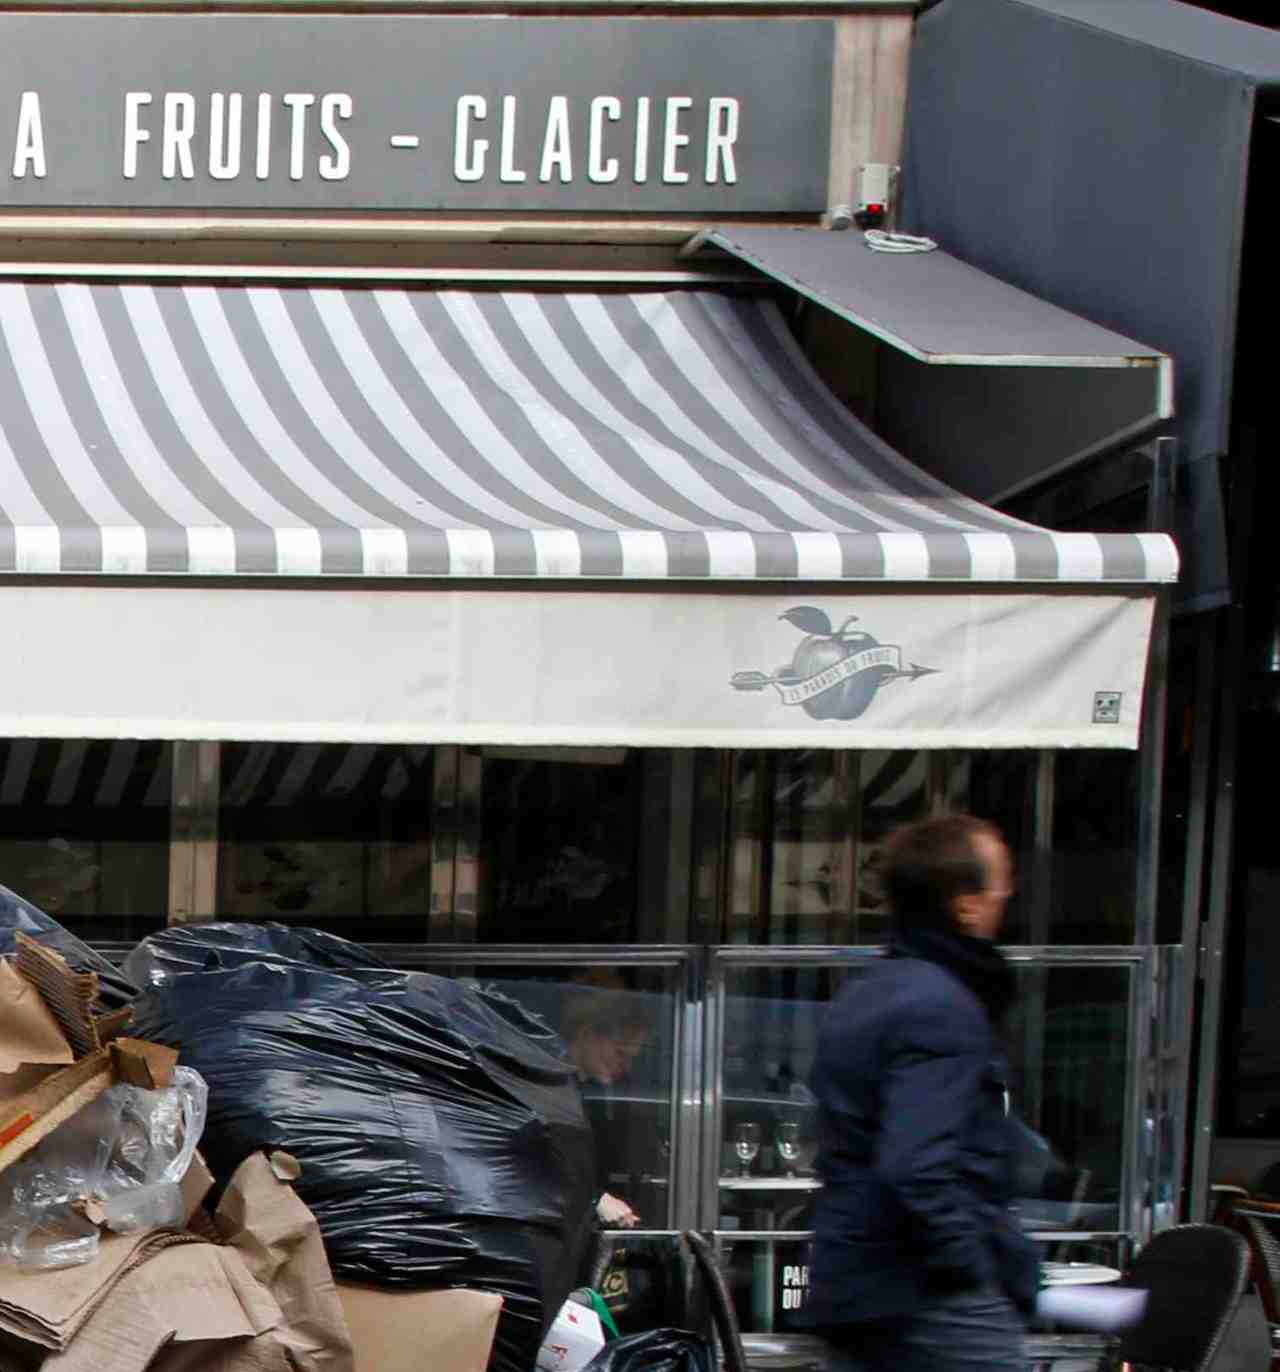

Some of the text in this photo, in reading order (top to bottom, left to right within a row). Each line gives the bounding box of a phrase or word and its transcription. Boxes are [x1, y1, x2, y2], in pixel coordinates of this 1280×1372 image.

[10, 90, 48, 180] A
[122, 91, 354, 183] FRUITS
[454, 94, 739, 185] GLACIER
